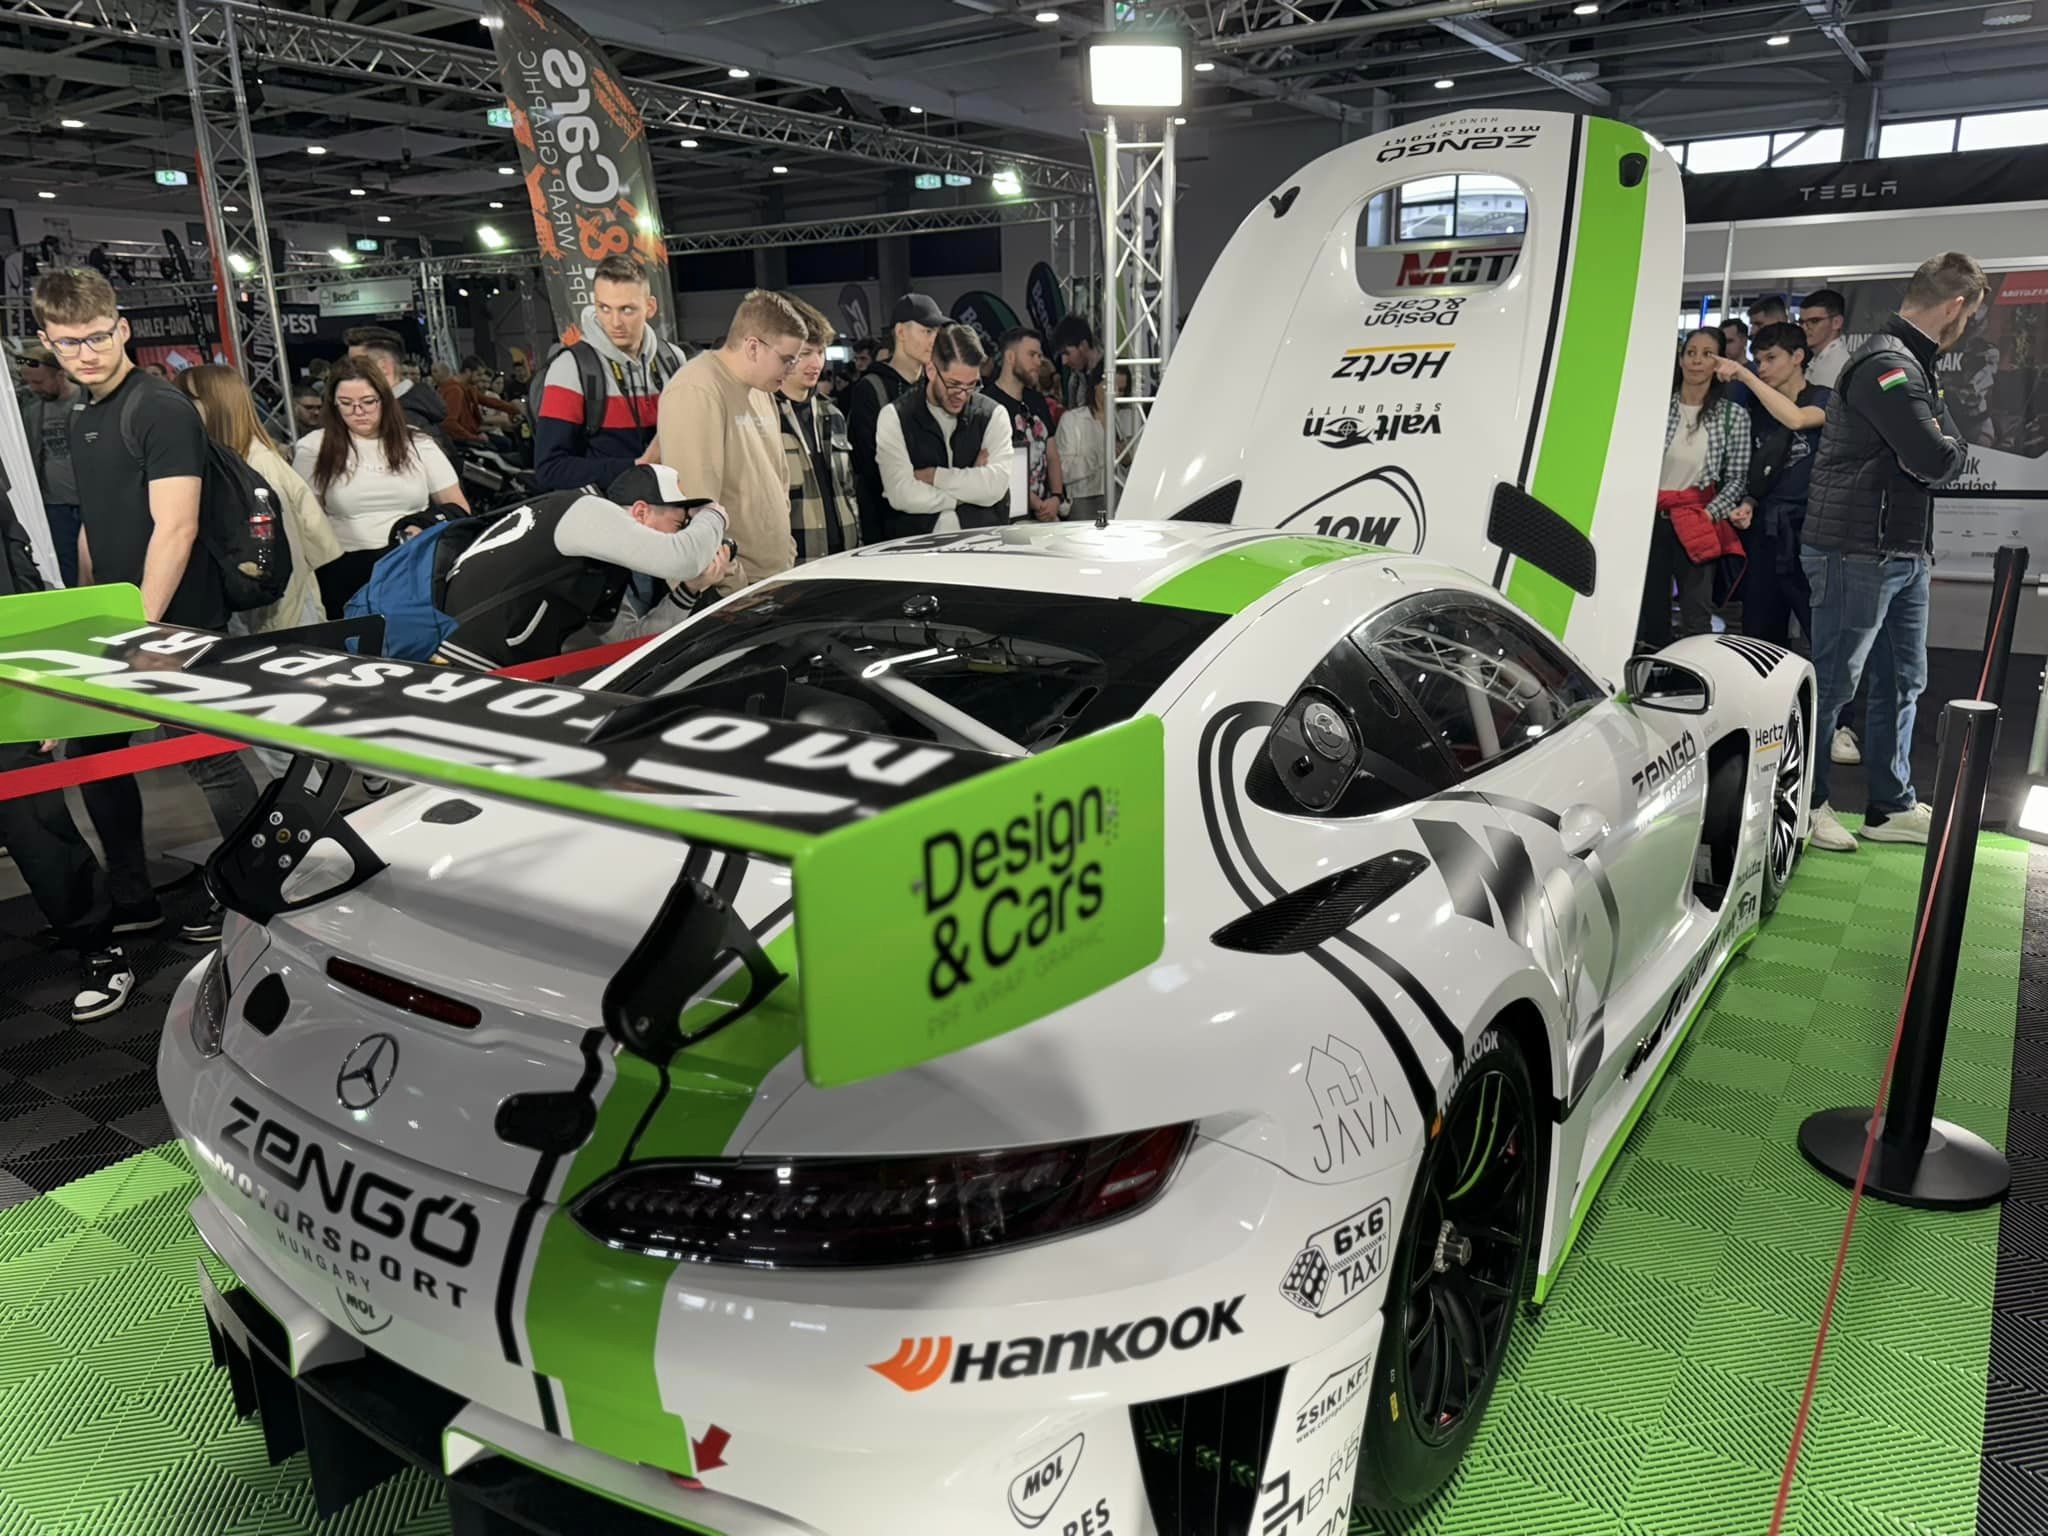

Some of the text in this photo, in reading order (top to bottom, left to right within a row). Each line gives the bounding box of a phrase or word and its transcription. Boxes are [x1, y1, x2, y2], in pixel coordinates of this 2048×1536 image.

[1383, 125, 1541, 147] MOTORSPORT
[1800, 180, 1898, 201] TESLA
[1397, 250, 1519, 287] MOT
[1364, 309, 1460, 328] Design
[1373, 297, 1467, 311] & Cars
[1331, 350, 1452, 382] Hertz
[1308, 402, 1442, 416] SECURITY
[1755, 723, 1785, 748] Hertz
[922, 785, 1104, 917] Design
[928, 860, 1105, 1000] & Cars
[1312, 1094, 1402, 1174] JAVA
[213, 1152, 468, 1309] MOTORSPORT
[1333, 1206, 1385, 1256] 6x6
[276, 1227, 371, 1294] HUNGARY
[1338, 1243, 1383, 1296] TAXI
[345, 1292, 377, 1320] MOL
[1295, 1386, 1343, 1434] ZSIKI
[1345, 1356, 1372, 1395] KFT
[1022, 1455, 1063, 1501] MOL
